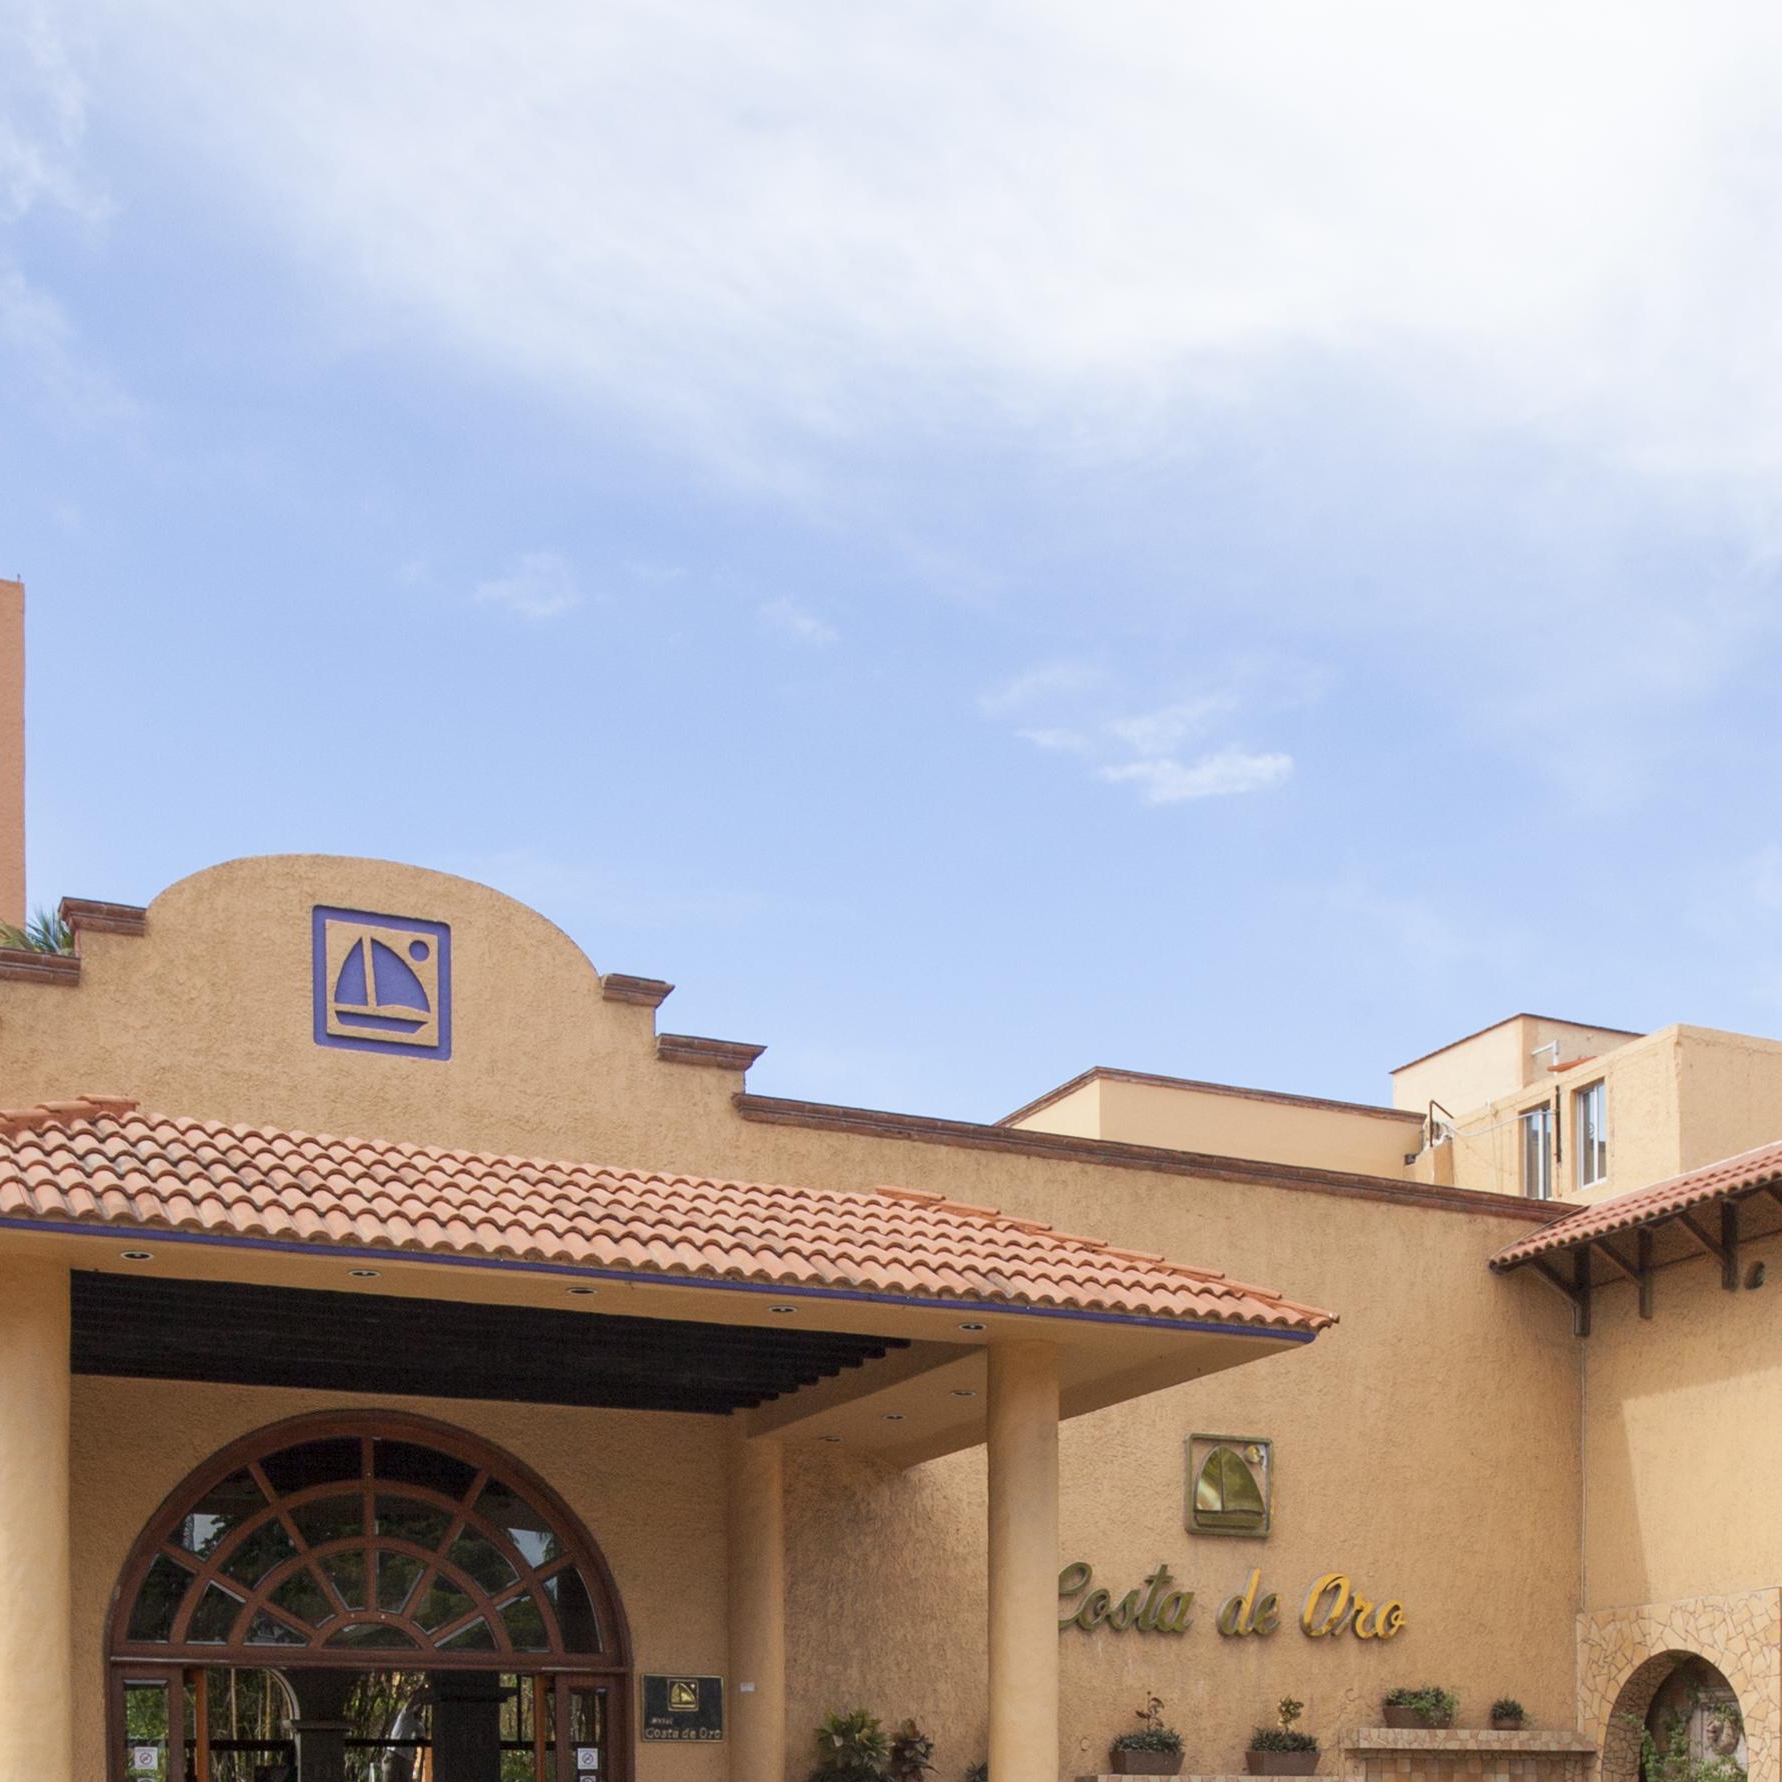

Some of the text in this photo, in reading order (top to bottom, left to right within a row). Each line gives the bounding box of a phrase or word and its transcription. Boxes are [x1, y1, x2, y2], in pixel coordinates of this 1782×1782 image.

[1058, 1561, 1408, 1641] Costa de Oro
[645, 1727, 722, 1739] Costa de Oro
